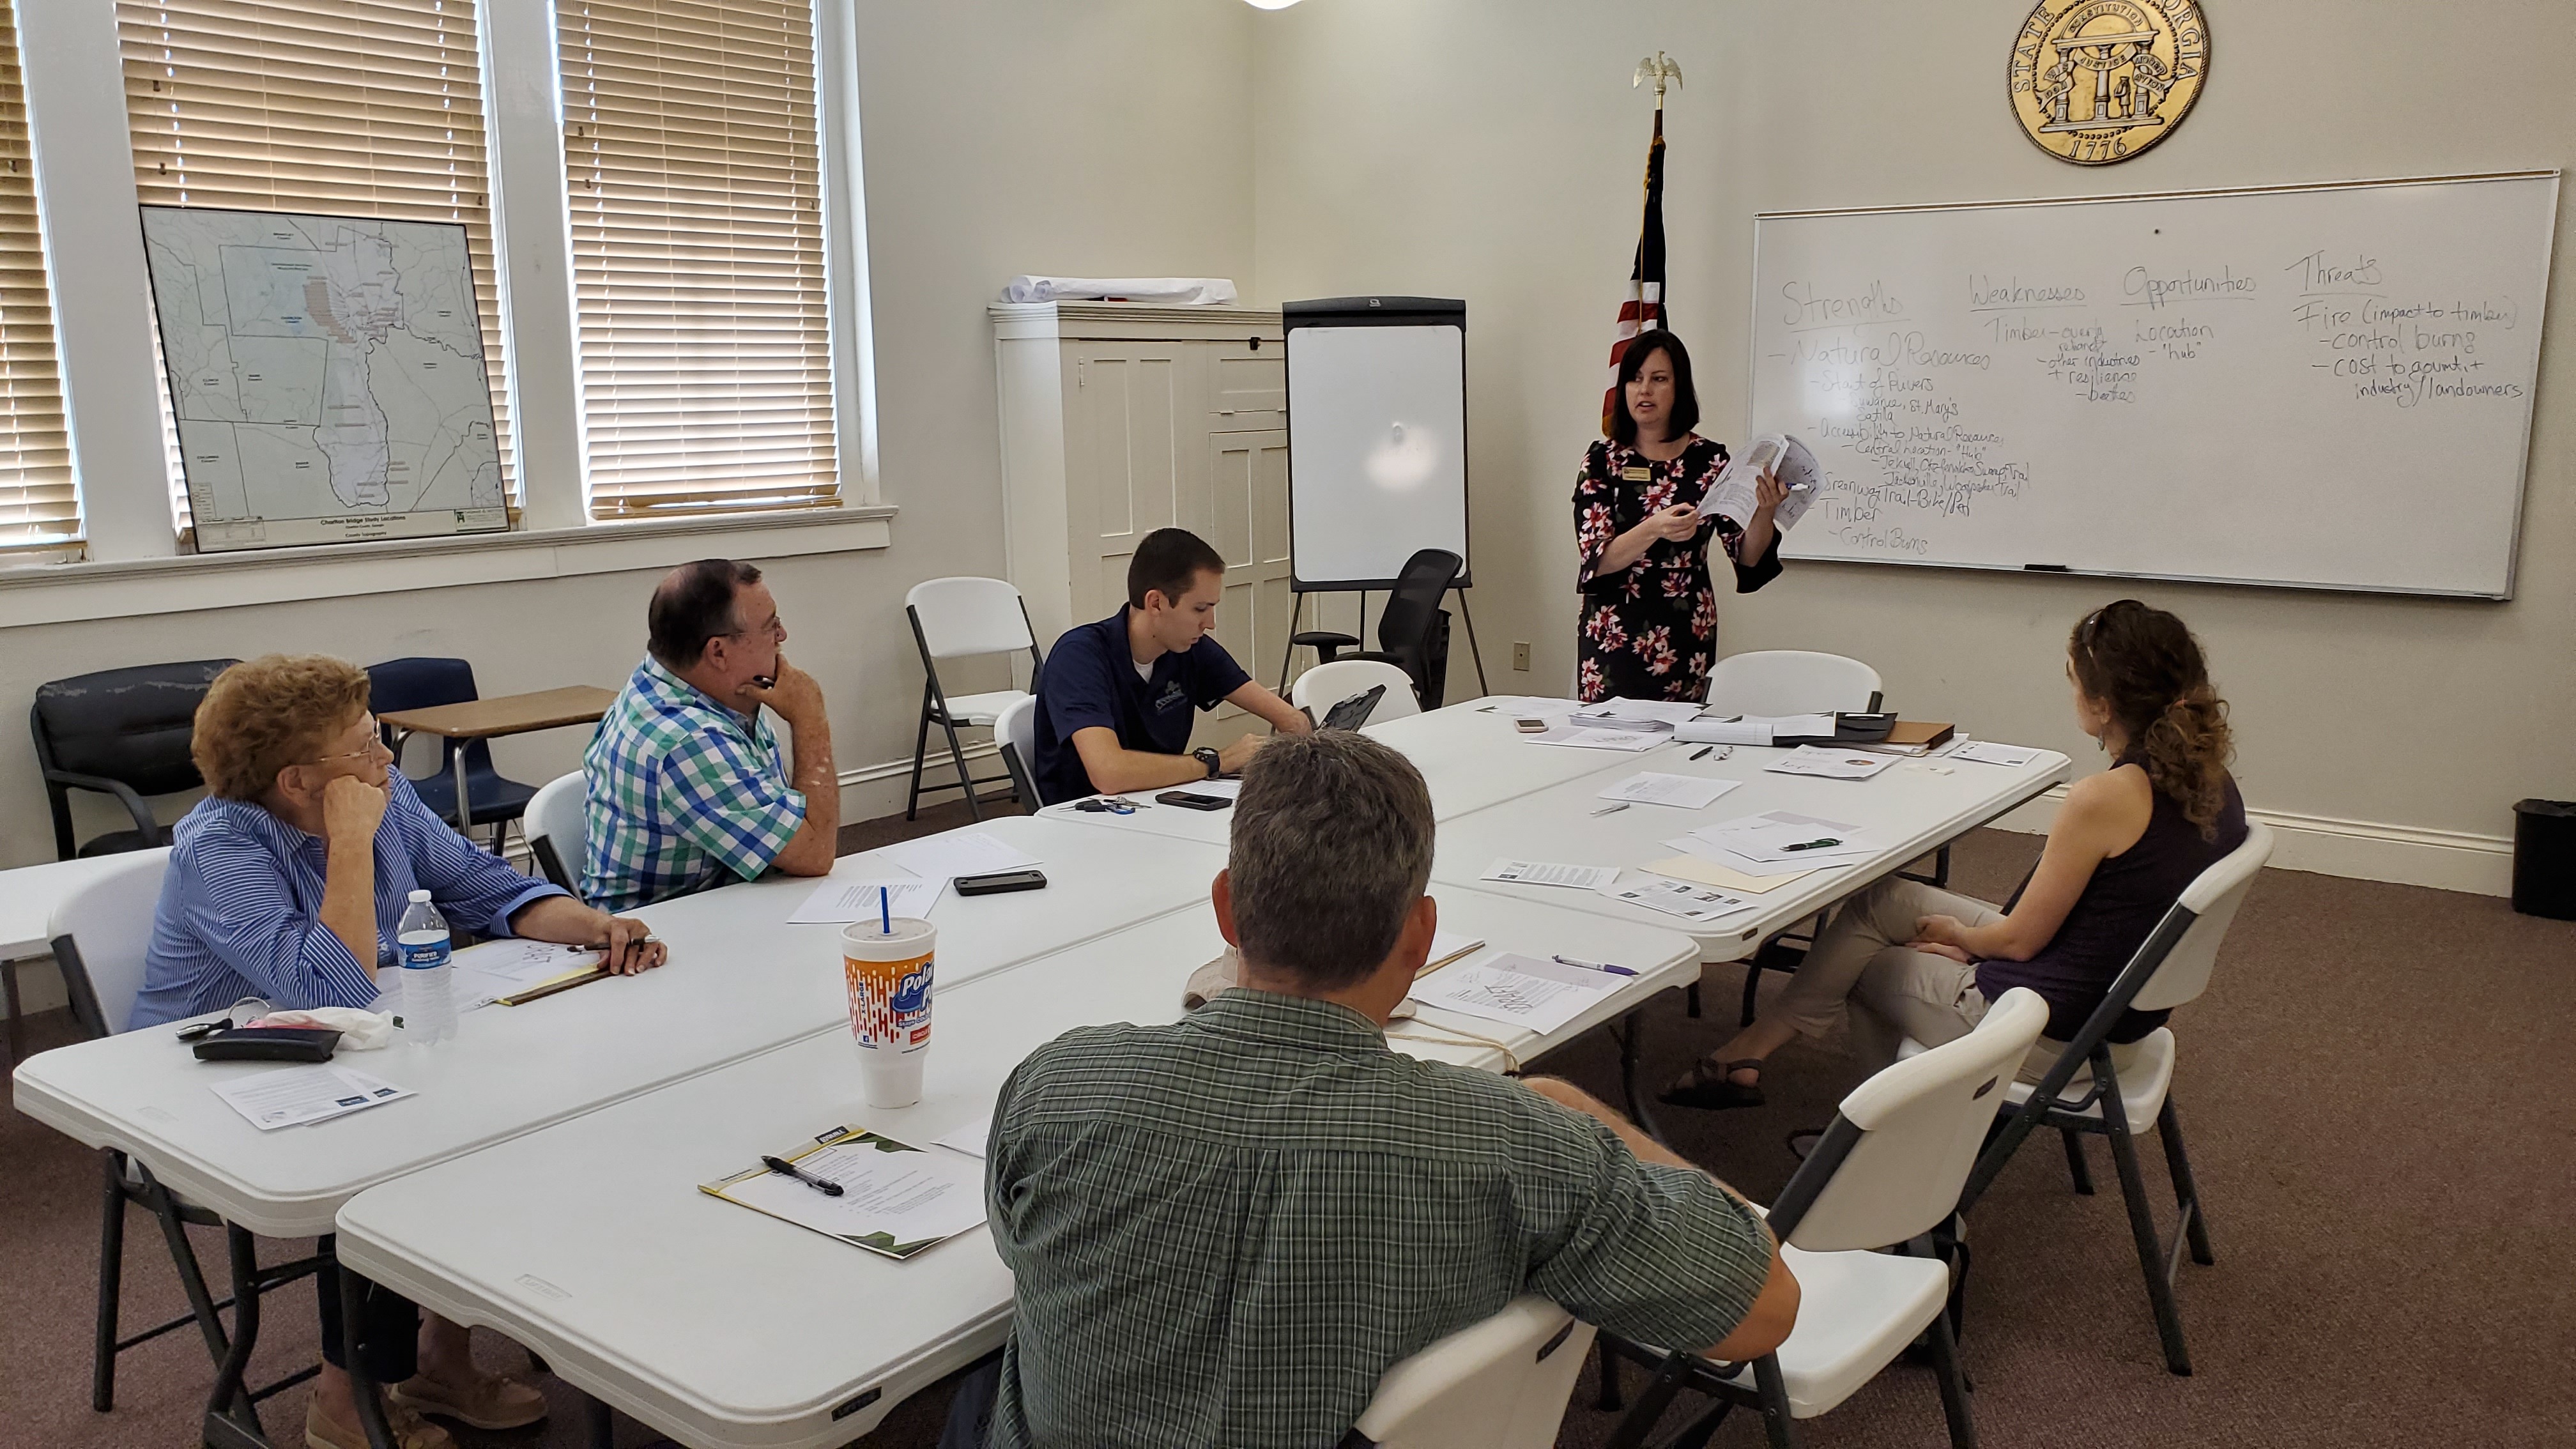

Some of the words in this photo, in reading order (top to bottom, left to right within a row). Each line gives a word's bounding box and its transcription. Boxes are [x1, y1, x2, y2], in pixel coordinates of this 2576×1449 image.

[2069, 3, 2143, 33] CONSTITUTION
[2013, 6, 2055, 93] STATE
[2163, 0, 2202, 81] ORGIA
[2080, 54, 2127, 69] JUSTICE
[2068, 137, 2127, 159] 1776
[2285, 250, 2382, 291] Threats
[1970, 274, 2085, 305] Weaknesses
[2124, 265, 2257, 310] Opportunities
[1783, 280, 1903, 337] Strengths
[2293, 301, 2351, 331] Fire
[2426, 302, 2444, 318] to
[2136, 318, 2214, 342] Location
[2386, 354, 2405, 374] to
[1869, 367, 1885, 397] of
[1889, 371, 1934, 392] Rivers
[1890, 425, 1905, 440] to
[1819, 496, 1882, 523] Timber
